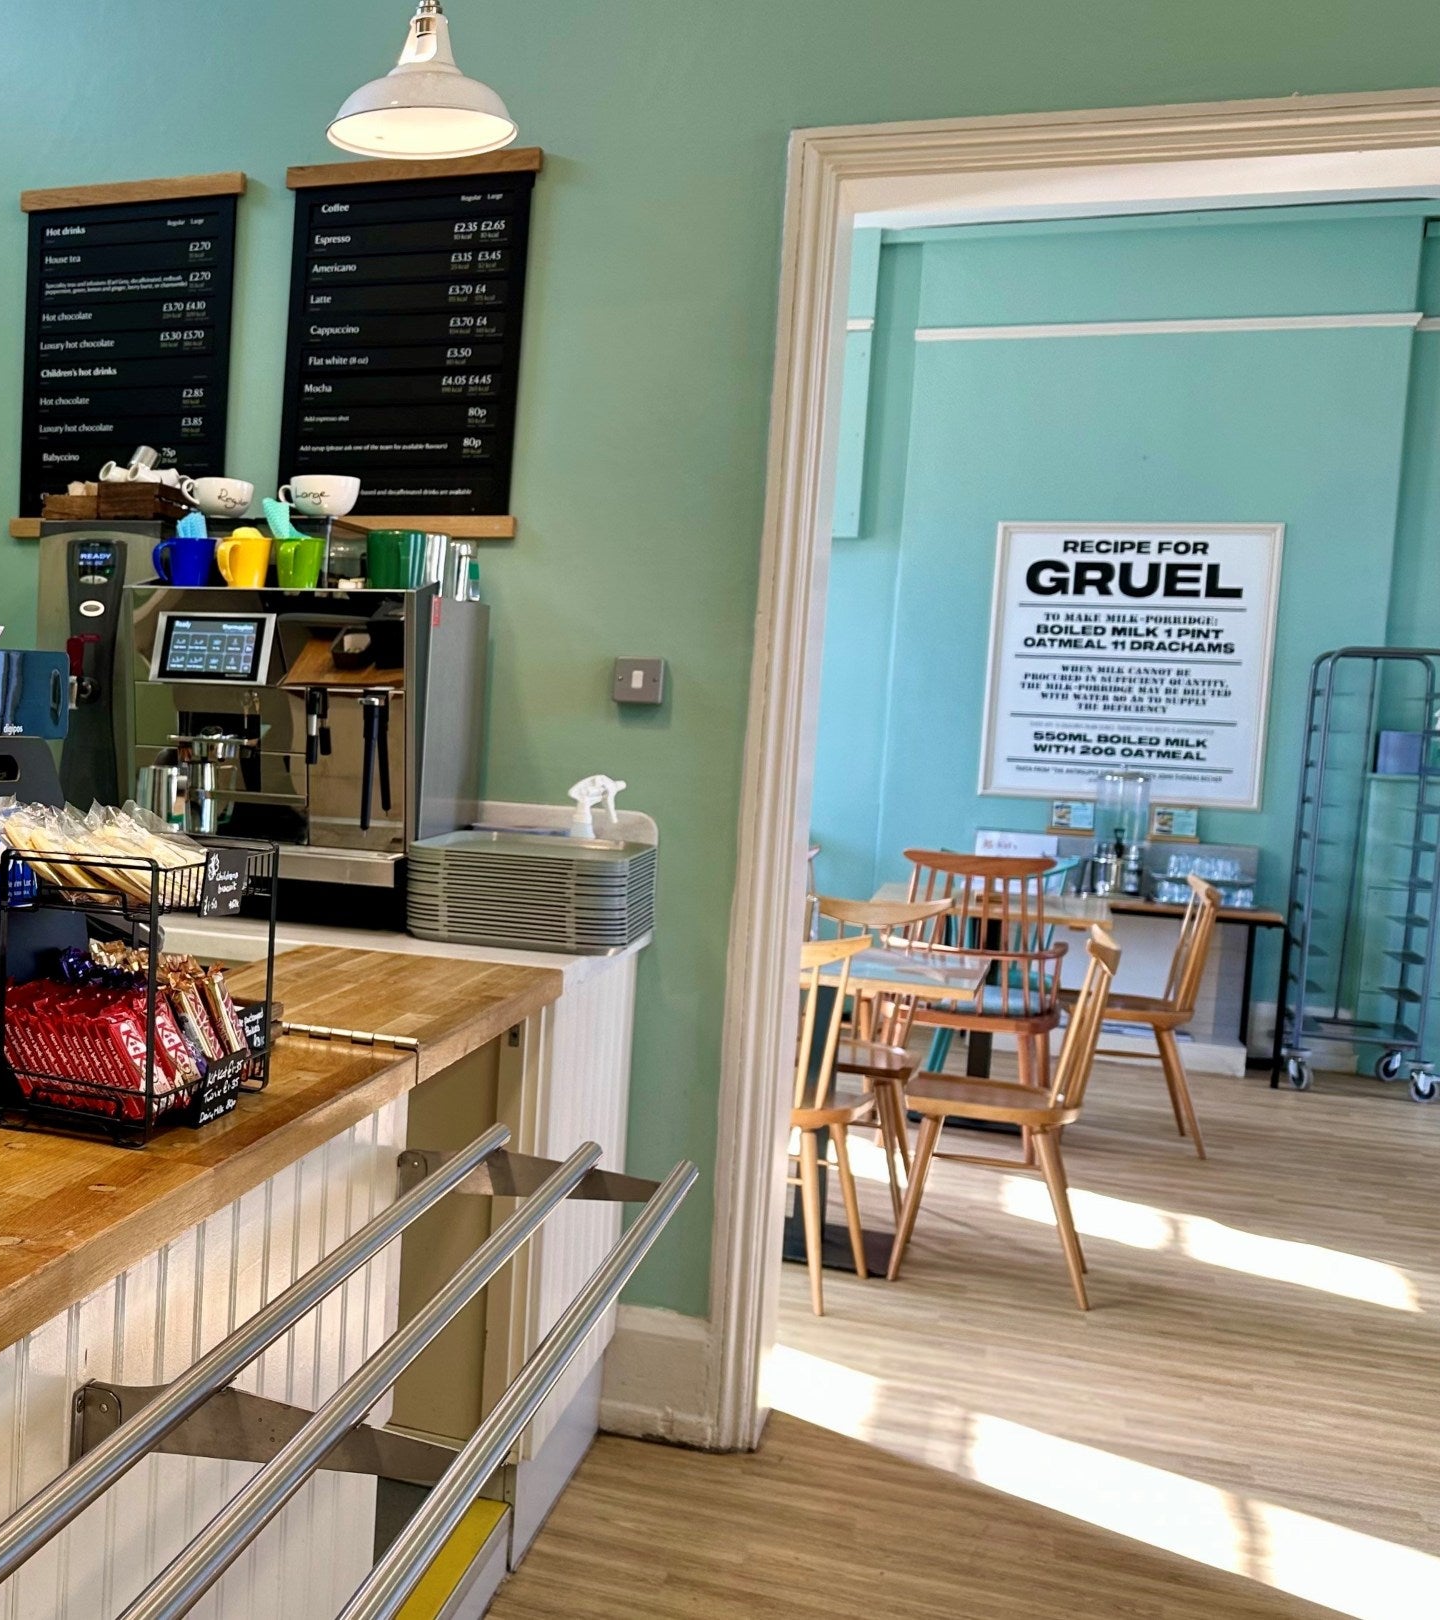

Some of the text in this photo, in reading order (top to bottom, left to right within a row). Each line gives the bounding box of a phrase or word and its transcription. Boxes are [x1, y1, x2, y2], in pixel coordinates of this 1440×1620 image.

[322, 204, 349, 213] Coffee
[46, 226, 85, 236] Hot drinks
[315, 221, 505, 245] Espresso £2.35 £2.65
[45, 242, 210, 264] House tea £2.70
[312, 251, 502, 273] Americano £3.15 £3.45
[189, 272, 210, 281] £2.70
[311, 285, 486, 303] Latte £3.70 £4
[42, 313, 58, 322] Hot
[58, 312, 92, 321] chocolate
[163, 302, 184, 311] £3.70
[311, 317, 487, 335] Cappuccino £3.70 £4
[40, 342, 64, 351] Luxury
[80, 339, 115, 348] chocolate
[161, 331, 181, 340] £5.30
[183, 331, 204, 339] £5.70
[309, 348, 471, 365] Flat white £3.50
[41, 367, 117, 378] Children's hot drinks
[304, 375, 492, 393] Mocha £4.05 £4.45
[40, 389, 203, 405] Hot chocolate £2.85
[468, 407, 486, 418] 80p
[39, 425, 63, 434] Luxury
[78, 423, 113, 432] chocolate
[182, 418, 202, 427] £3.85
[463, 438, 481, 448] 80p
[43, 453, 79, 463] Babyccino
[296, 488, 330, 504] Large
[1063, 540, 1209, 556] RECIPE FOR
[1026, 560, 1243, 599] GRUEL
[1044, 612, 1060, 622] TO
[1064, 612, 1101, 622] MAKE
[1036, 624, 1224, 639] BOILED MILK 1 PINT
[1024, 638, 1235, 654] OATMEAL 11 DRACHAMS
[1062, 664, 1191, 676] WHEN MILK CANNOT BE
[1041, 692, 1069, 700] WITH
[1073, 693, 1109, 702] WATER
[1166, 696, 1207, 706] SUPPLY
[1077, 703, 1168, 714] THE DEFICIENCY
[1033, 731, 1208, 748] 550ML BOILED MILK
[1033, 743, 1206, 761] WITH 20G OATMEAL
